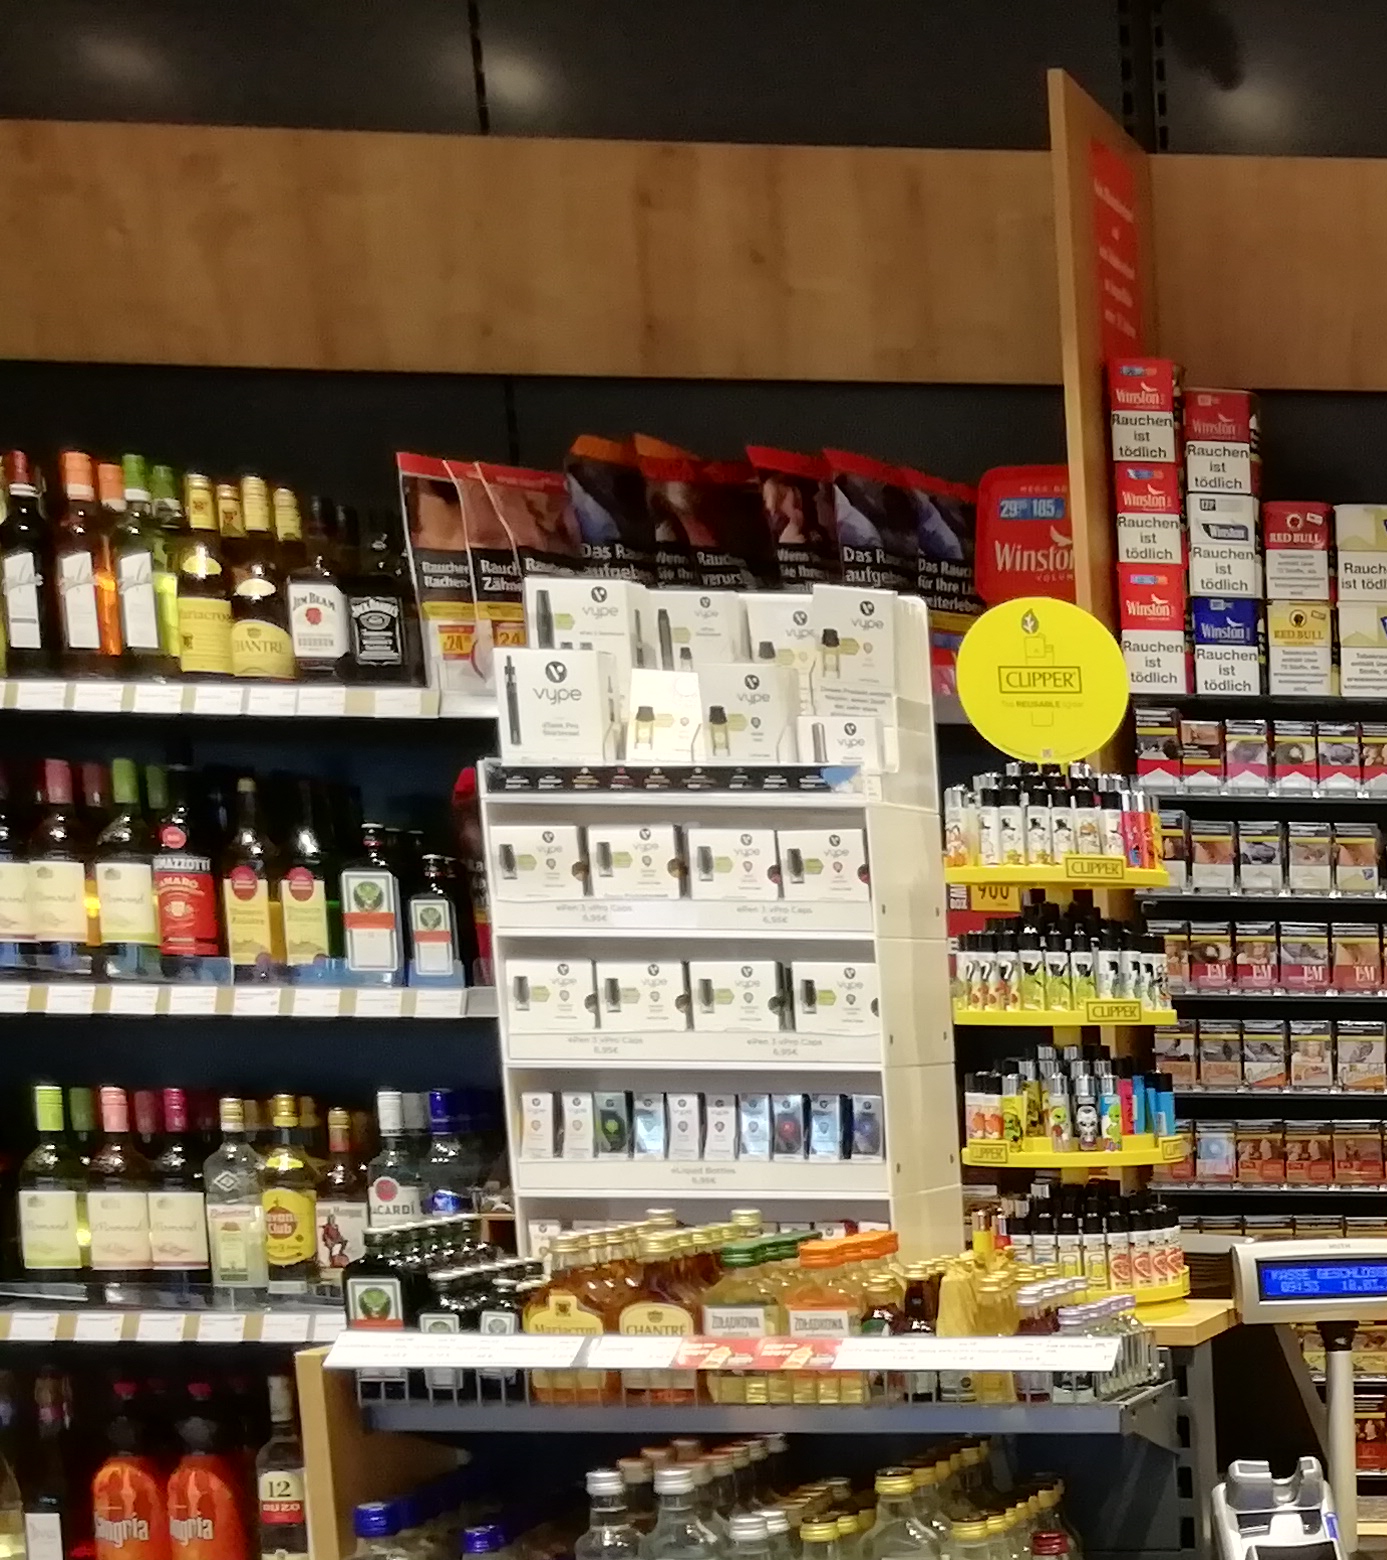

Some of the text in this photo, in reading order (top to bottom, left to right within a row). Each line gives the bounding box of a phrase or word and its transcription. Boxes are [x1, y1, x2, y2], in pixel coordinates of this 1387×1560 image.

[1116, 388, 1159, 405] Winston
[1112, 415, 1172, 427] Rauchen
[1134, 431, 1150, 442] ist
[1120, 446, 1166, 458] tödlich
[1269, 533, 1320, 543] RED BULL
[582, 605, 619, 617] vype
[1127, 600, 1170, 617] Winston
[851, 618, 883, 630] vype
[1202, 623, 1244, 639] Winston
[1197, 649, 1257, 661] Rauchen
[1219, 665, 1235, 676] ist
[1006, 672, 1073, 688] CLIPPER
[1204, 680, 1251, 692] tödlich
[533, 687, 582, 704] vype
[737, 691, 770, 703] vype
